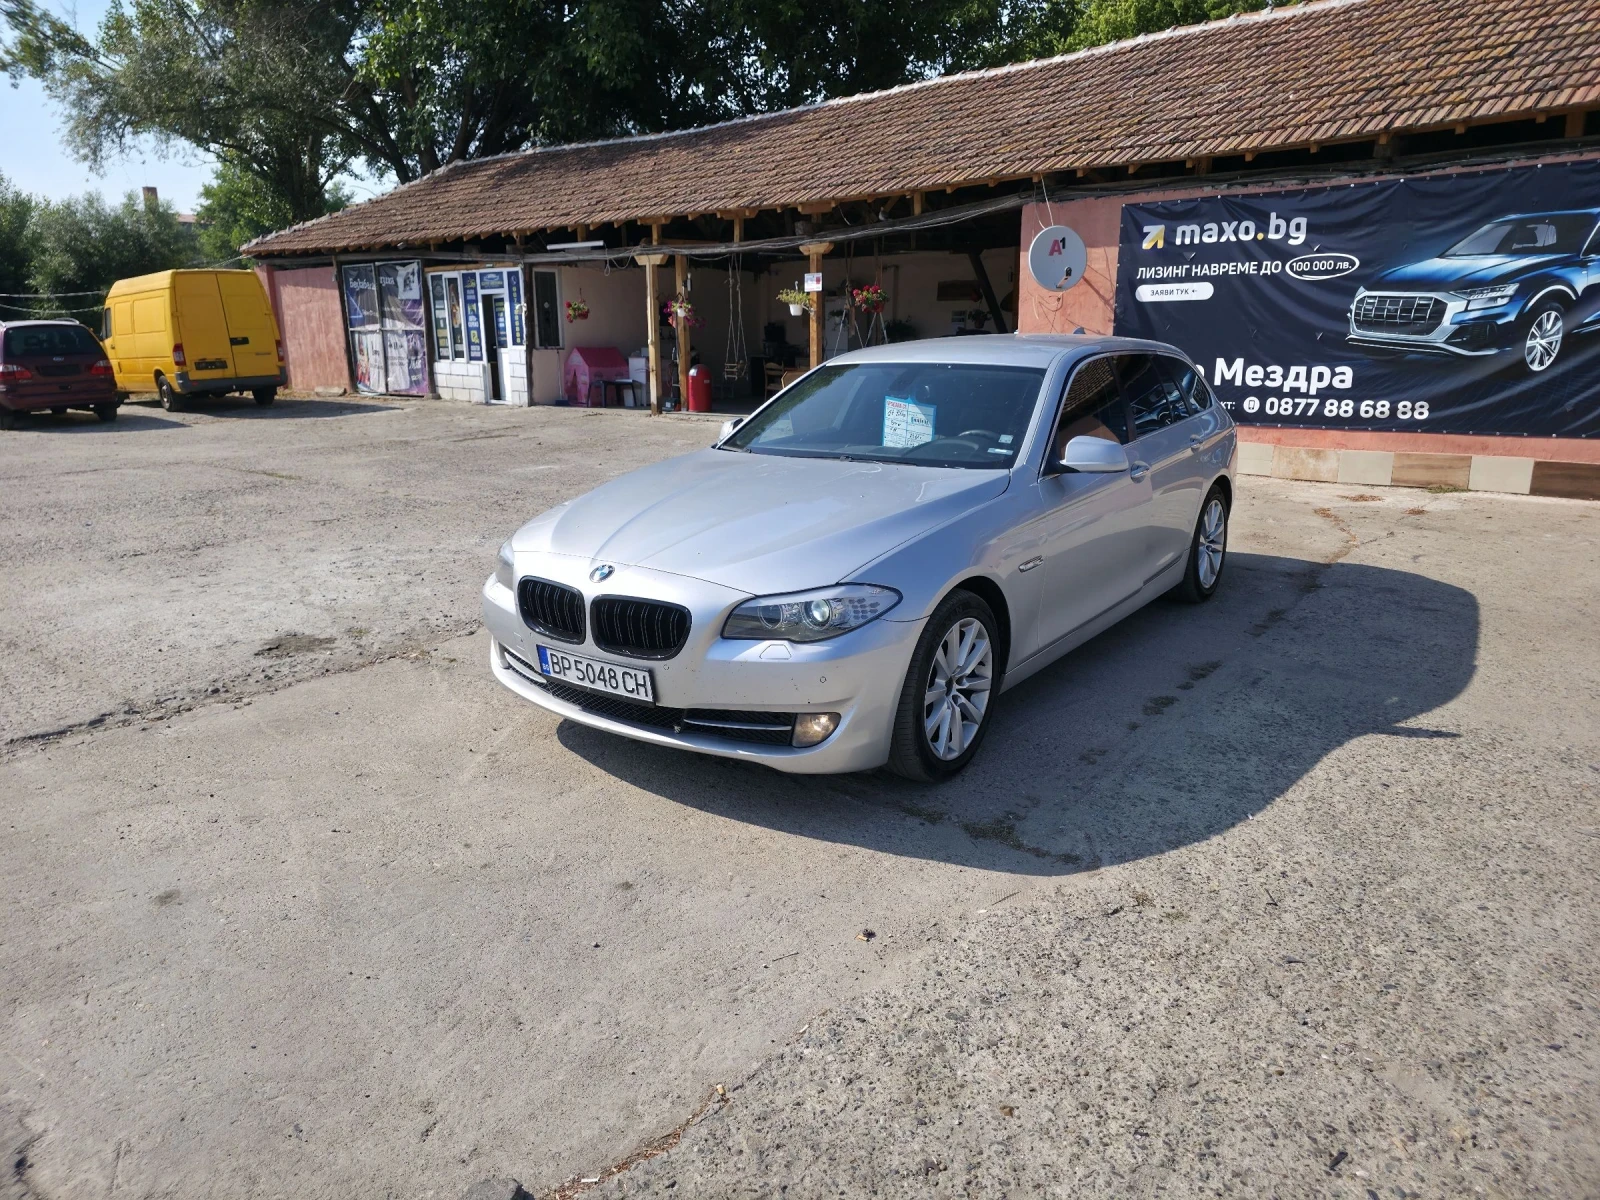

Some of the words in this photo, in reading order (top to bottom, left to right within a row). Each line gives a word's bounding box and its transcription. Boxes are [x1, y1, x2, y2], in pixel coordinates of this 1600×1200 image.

[1175, 212, 1307, 246] maxo.bg
[1048, 236, 1066, 256] A1
[1136, 264, 1190, 279] ЛИЗИНГ
[1191, 262, 1258, 277] НАВРЕМЕ
[1259, 260, 1282, 276] ДО
[1292, 261, 1311, 272] 100
[1312, 260, 1334, 271] 000
[1335, 261, 1352, 270] лв.
[1175, 287, 1190, 296] ТУК
[1214, 357, 1353, 395] Мездра
[1265, 397, 1320, 416] 0877
[1323, 398, 1355, 418] 88
[1359, 399, 1391, 419] 68
[1396, 400, 1430, 420] 88
[543, 662, 550, 671] BG
[573, 659, 619, 690] 5048
